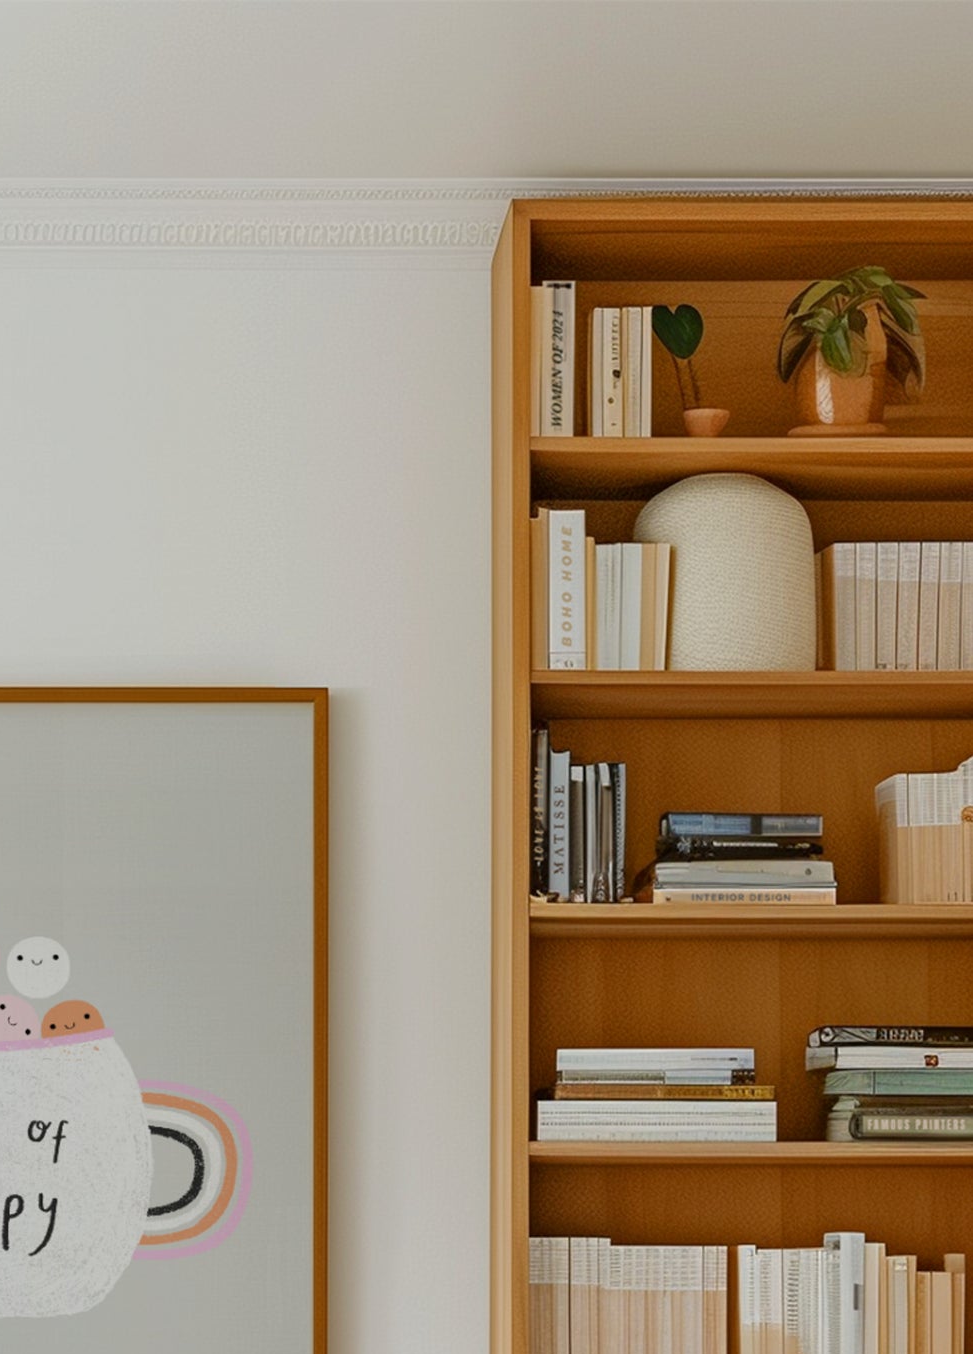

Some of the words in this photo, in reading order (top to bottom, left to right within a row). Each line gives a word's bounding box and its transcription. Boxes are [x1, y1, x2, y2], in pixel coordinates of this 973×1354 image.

[552, 310, 564, 342] 2024
[551, 342, 564, 364] OF
[551, 368, 563, 428] WOMEN
[561, 525, 573, 582] HOME
[561, 591, 573, 647] BOHO
[553, 785, 565, 875] MATISSE
[691, 893, 745, 901] INTERIOR
[750, 893, 791, 901] DESIGN
[27, 1119, 69, 1164] of
[867, 1119, 911, 1131] FAMOUS
[915, 1119, 966, 1131] PAINTERS
